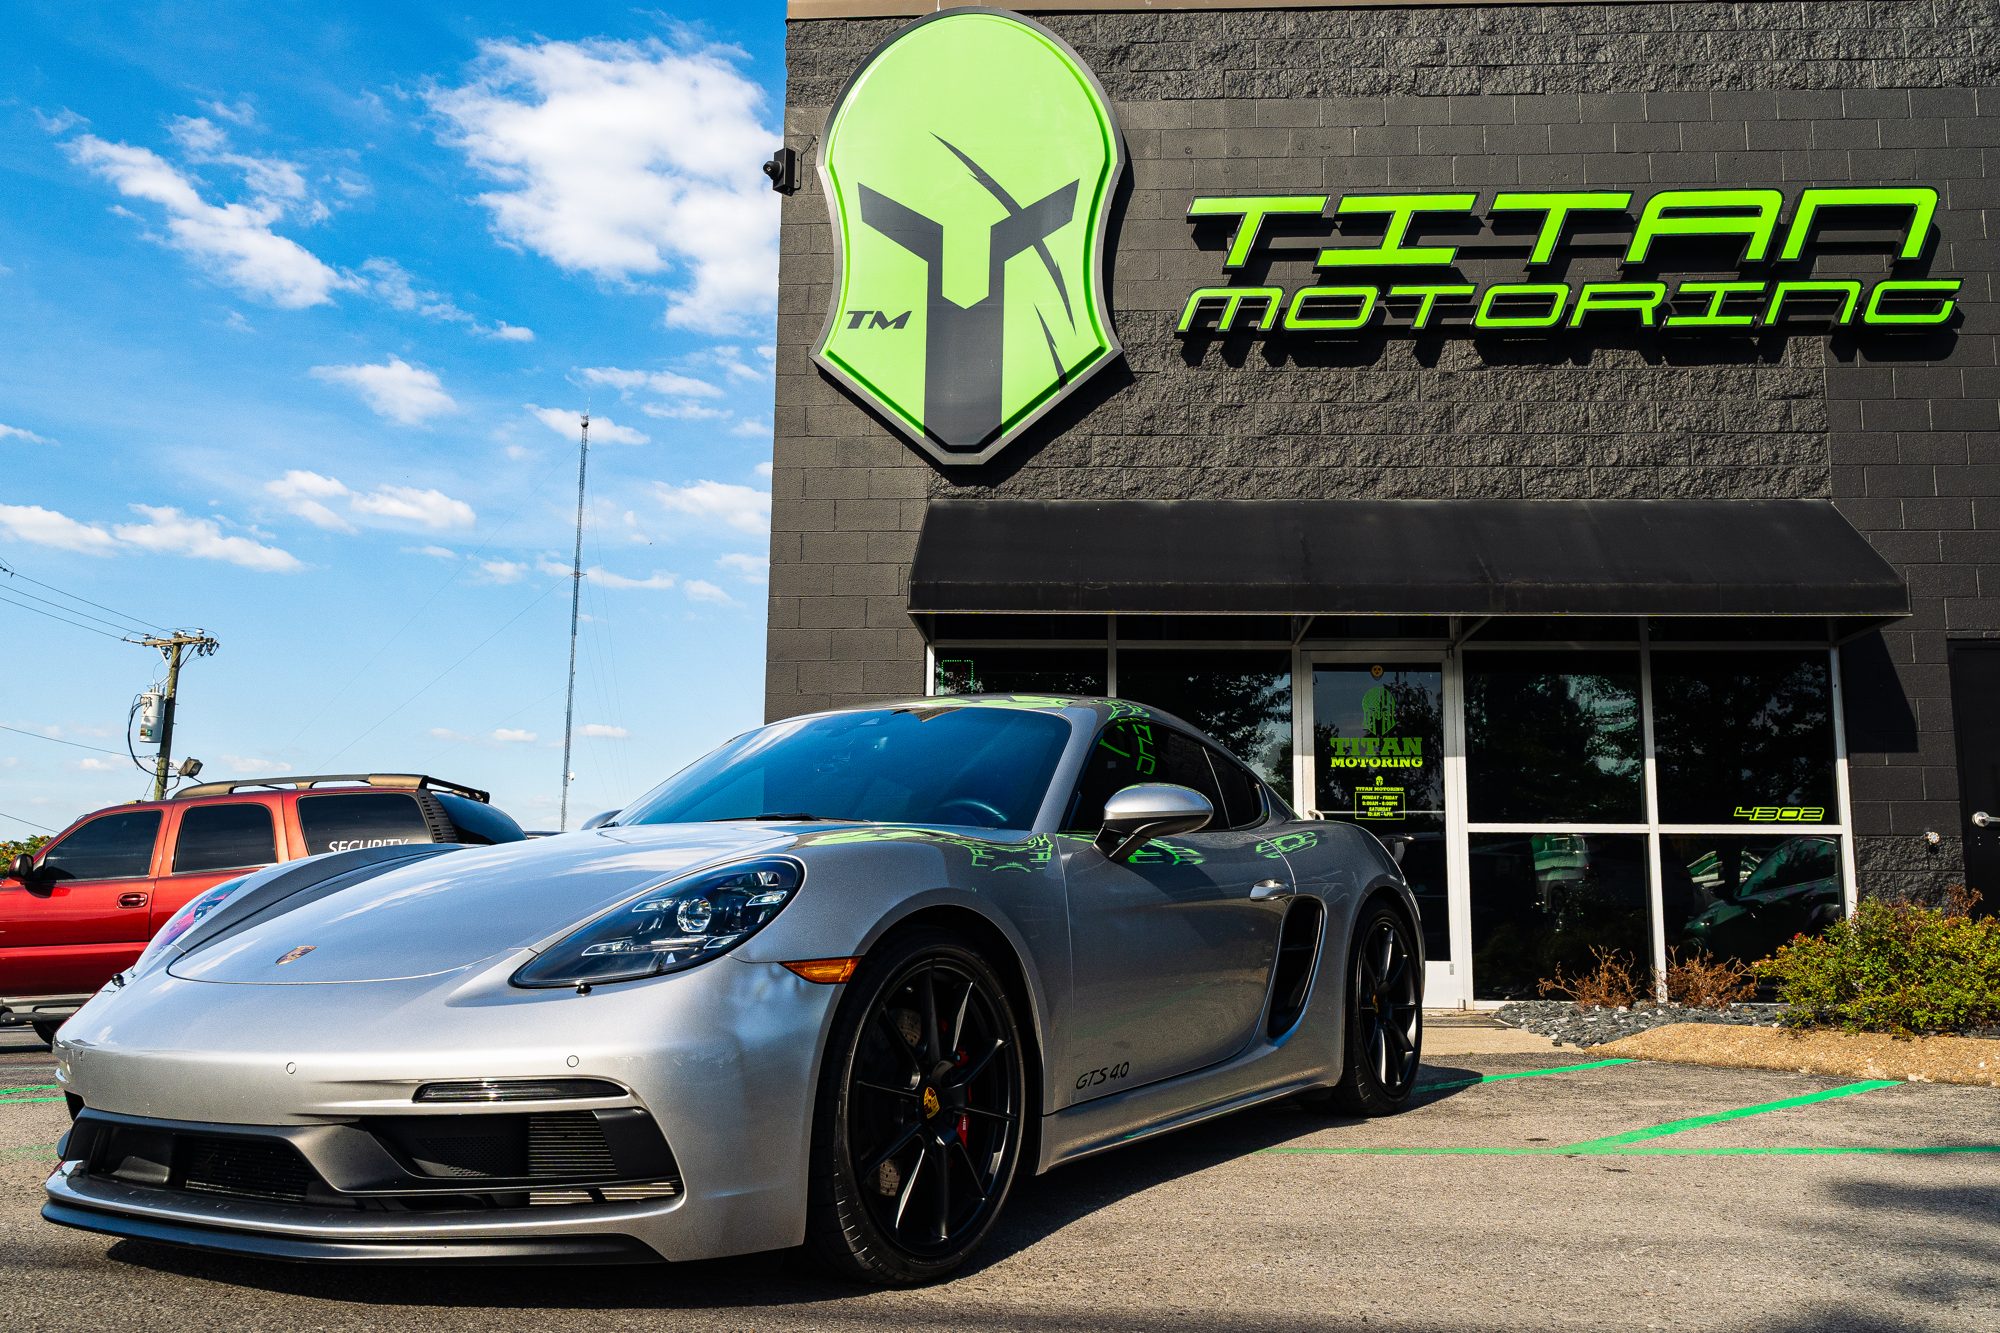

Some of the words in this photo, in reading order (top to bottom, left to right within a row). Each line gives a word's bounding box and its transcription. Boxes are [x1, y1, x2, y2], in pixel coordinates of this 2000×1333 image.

[1187, 186, 1938, 269] TITAN
[1176, 279, 1963, 334] MOTORING
[846, 310, 913, 330] TM
[1330, 737, 1422, 756] TITAN
[1330, 756, 1423, 768] MOTORING
[1733, 806, 1825, 821] 4302
[1076, 1066, 1109, 1089] GTS
